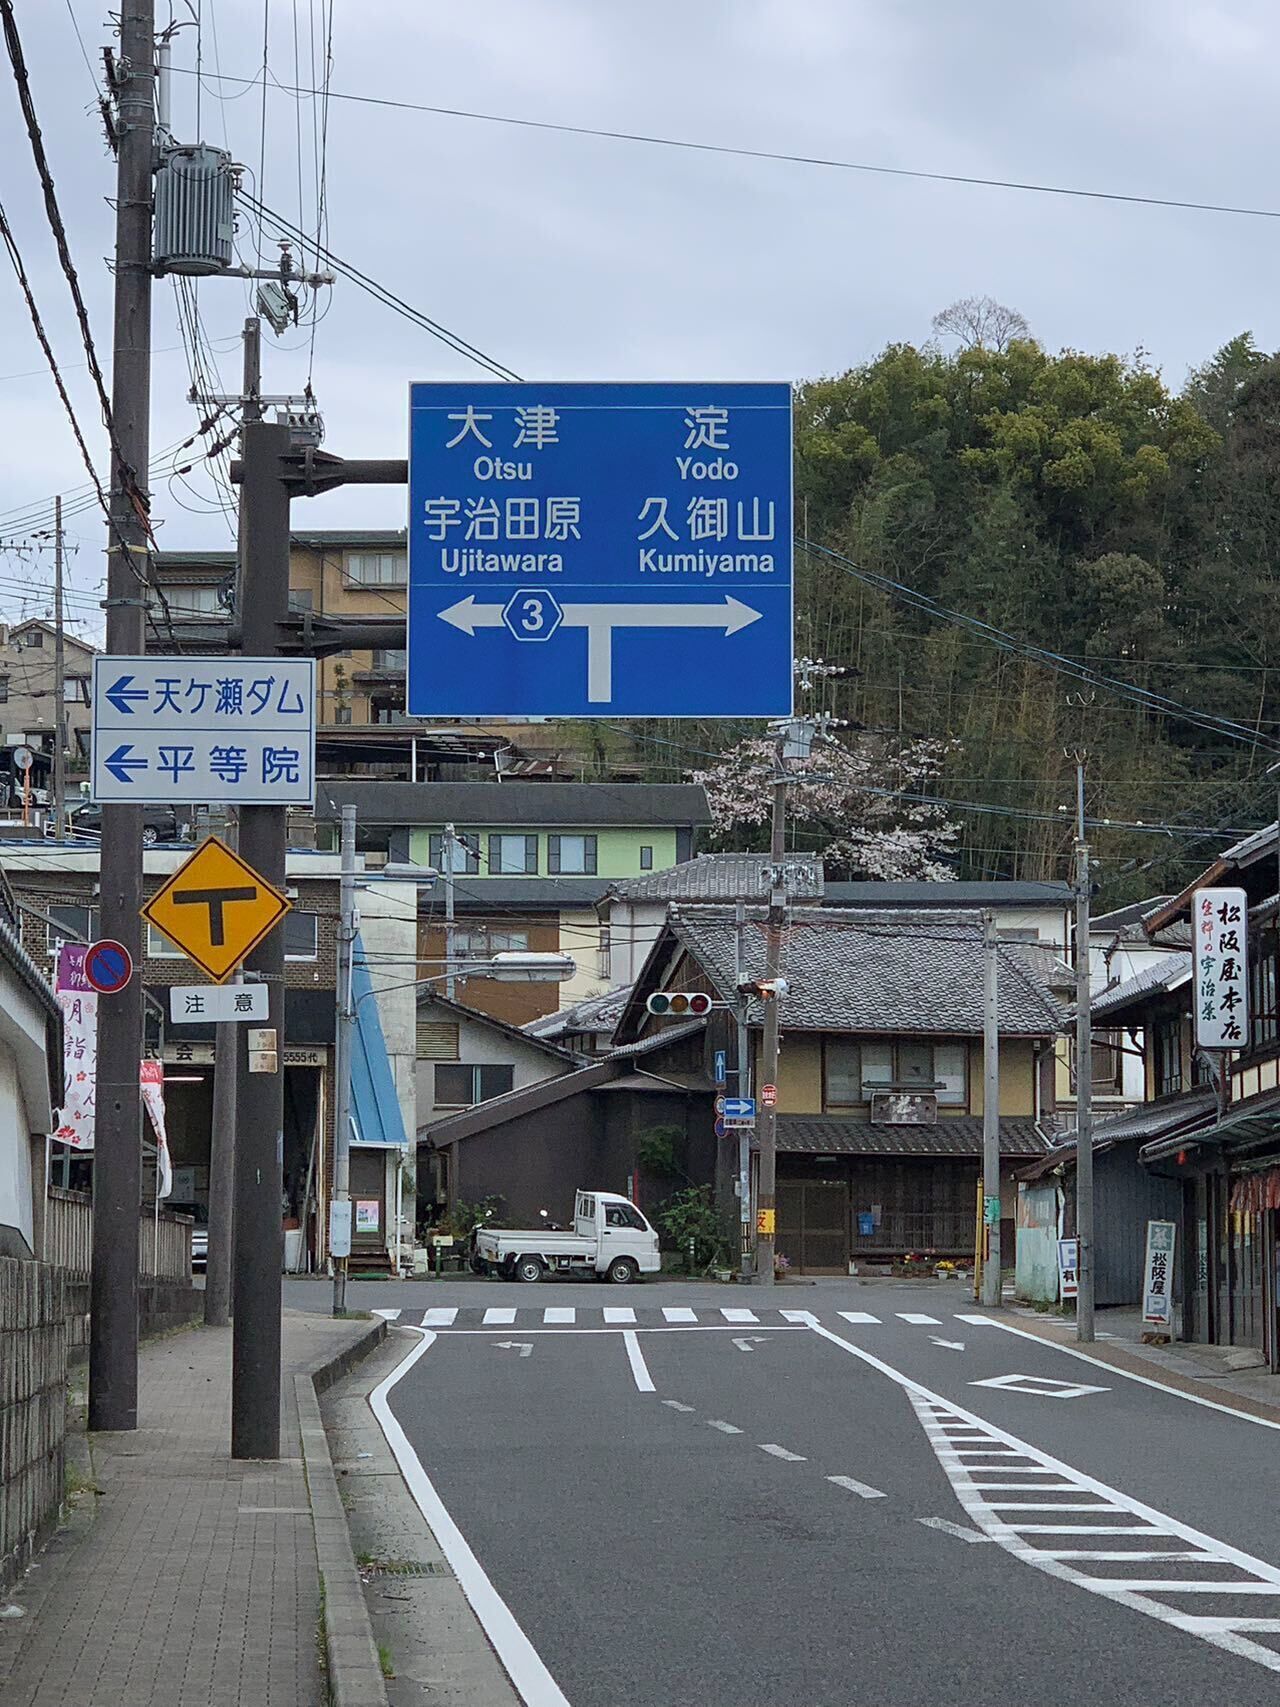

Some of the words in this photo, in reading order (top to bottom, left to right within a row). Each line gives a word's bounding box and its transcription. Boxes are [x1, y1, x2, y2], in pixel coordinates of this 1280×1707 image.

[446, 405, 560, 450] 大津
[683, 405, 730, 450] 淀
[473, 457, 533, 480] Otsu
[675, 457, 739, 480] Yodo
[424, 496, 581, 541] 宇治田原
[637, 496, 775, 542] 久御山
[441, 549, 563, 576] Ujitawara
[639, 549, 774, 577] Kumiyama
[521, 600, 544, 631] 3
[153, 676, 304, 715] 天ケ瀬ダム
[157, 745, 299, 784] 平等院
[1217, 902, 1242, 1040] 松阪屋本店
[185, 994, 253, 1013] 注意
[1150, 1252, 1167, 1295] 松阪屋
